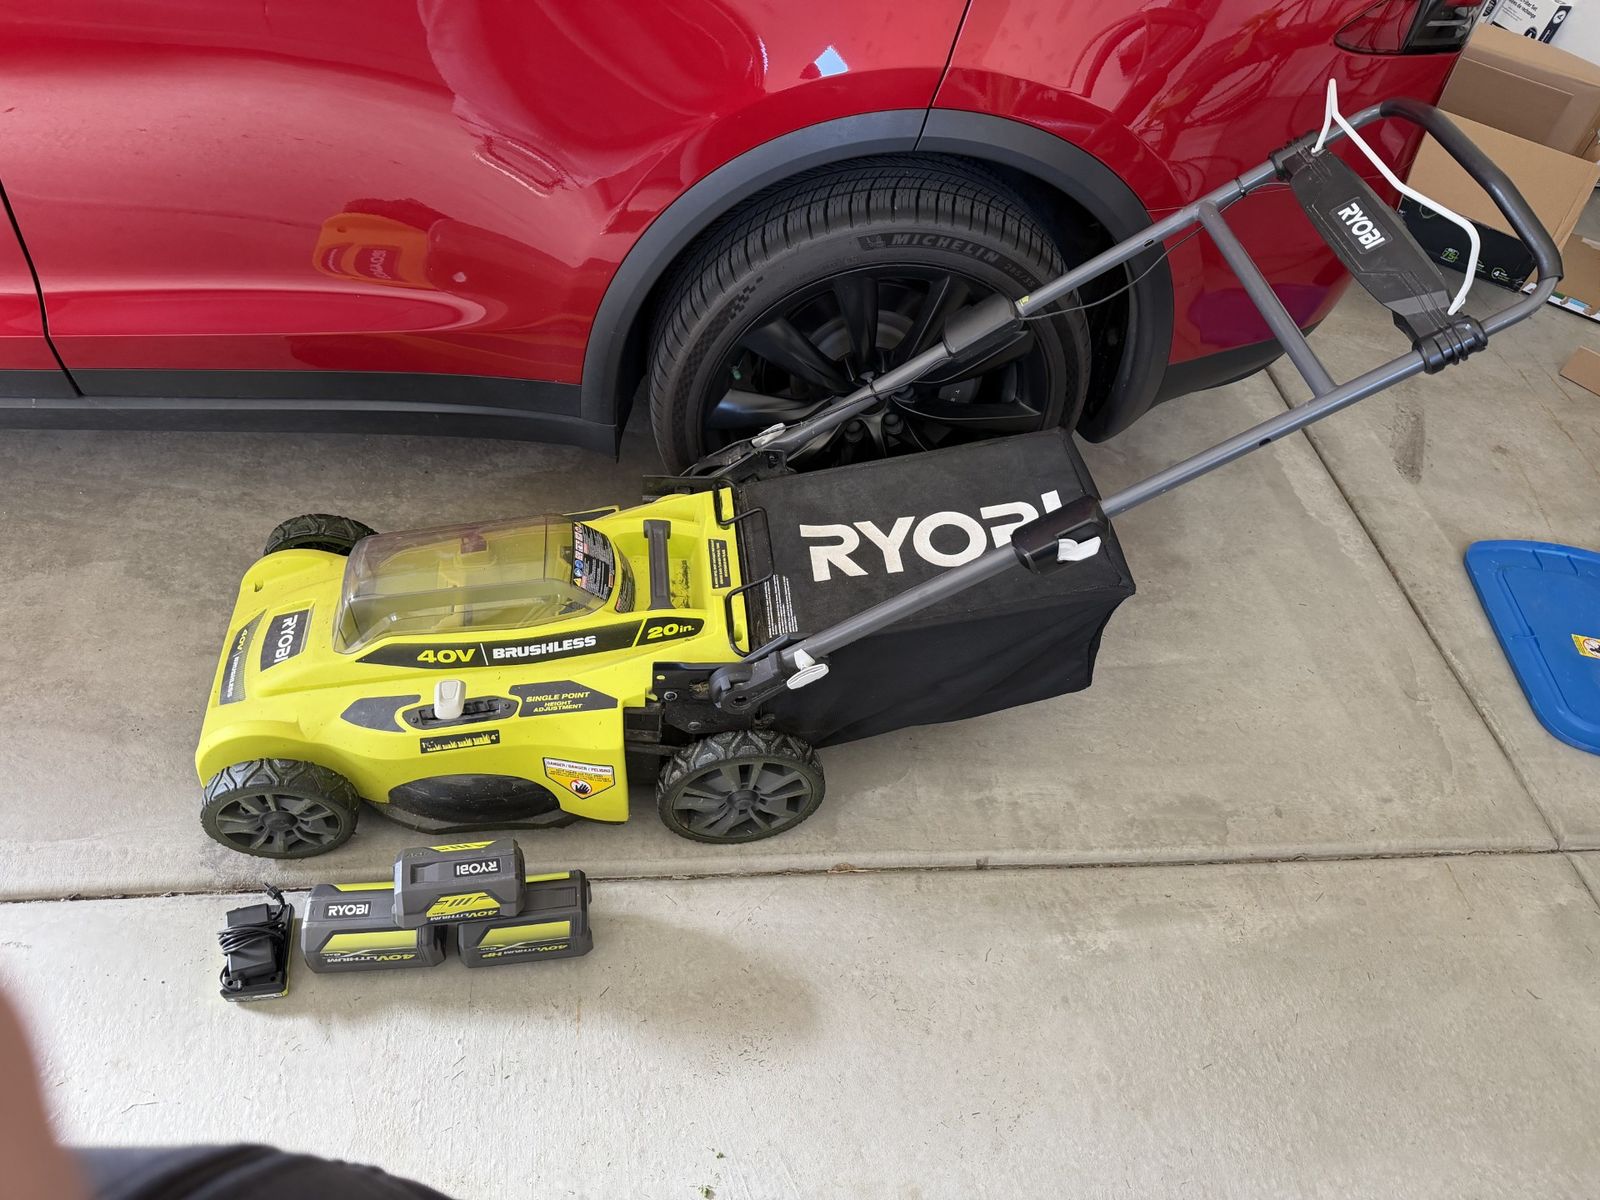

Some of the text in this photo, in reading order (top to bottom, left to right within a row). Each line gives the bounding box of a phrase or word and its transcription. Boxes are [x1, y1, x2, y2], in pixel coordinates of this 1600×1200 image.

[1337, 202, 1386, 250] RYOBI
[890, 233, 999, 263] MICHELIN
[236, 628, 248, 651] 40V
[273, 614, 299, 664] RYOBI
[416, 635, 597, 663] 40V BRUSHLESS
[526, 692, 591, 703] SINGLE POINT
[533, 703, 583, 713] ADJUSTMENT
[456, 860, 499, 876] RYOBI
[327, 903, 370, 917] RYOBI
